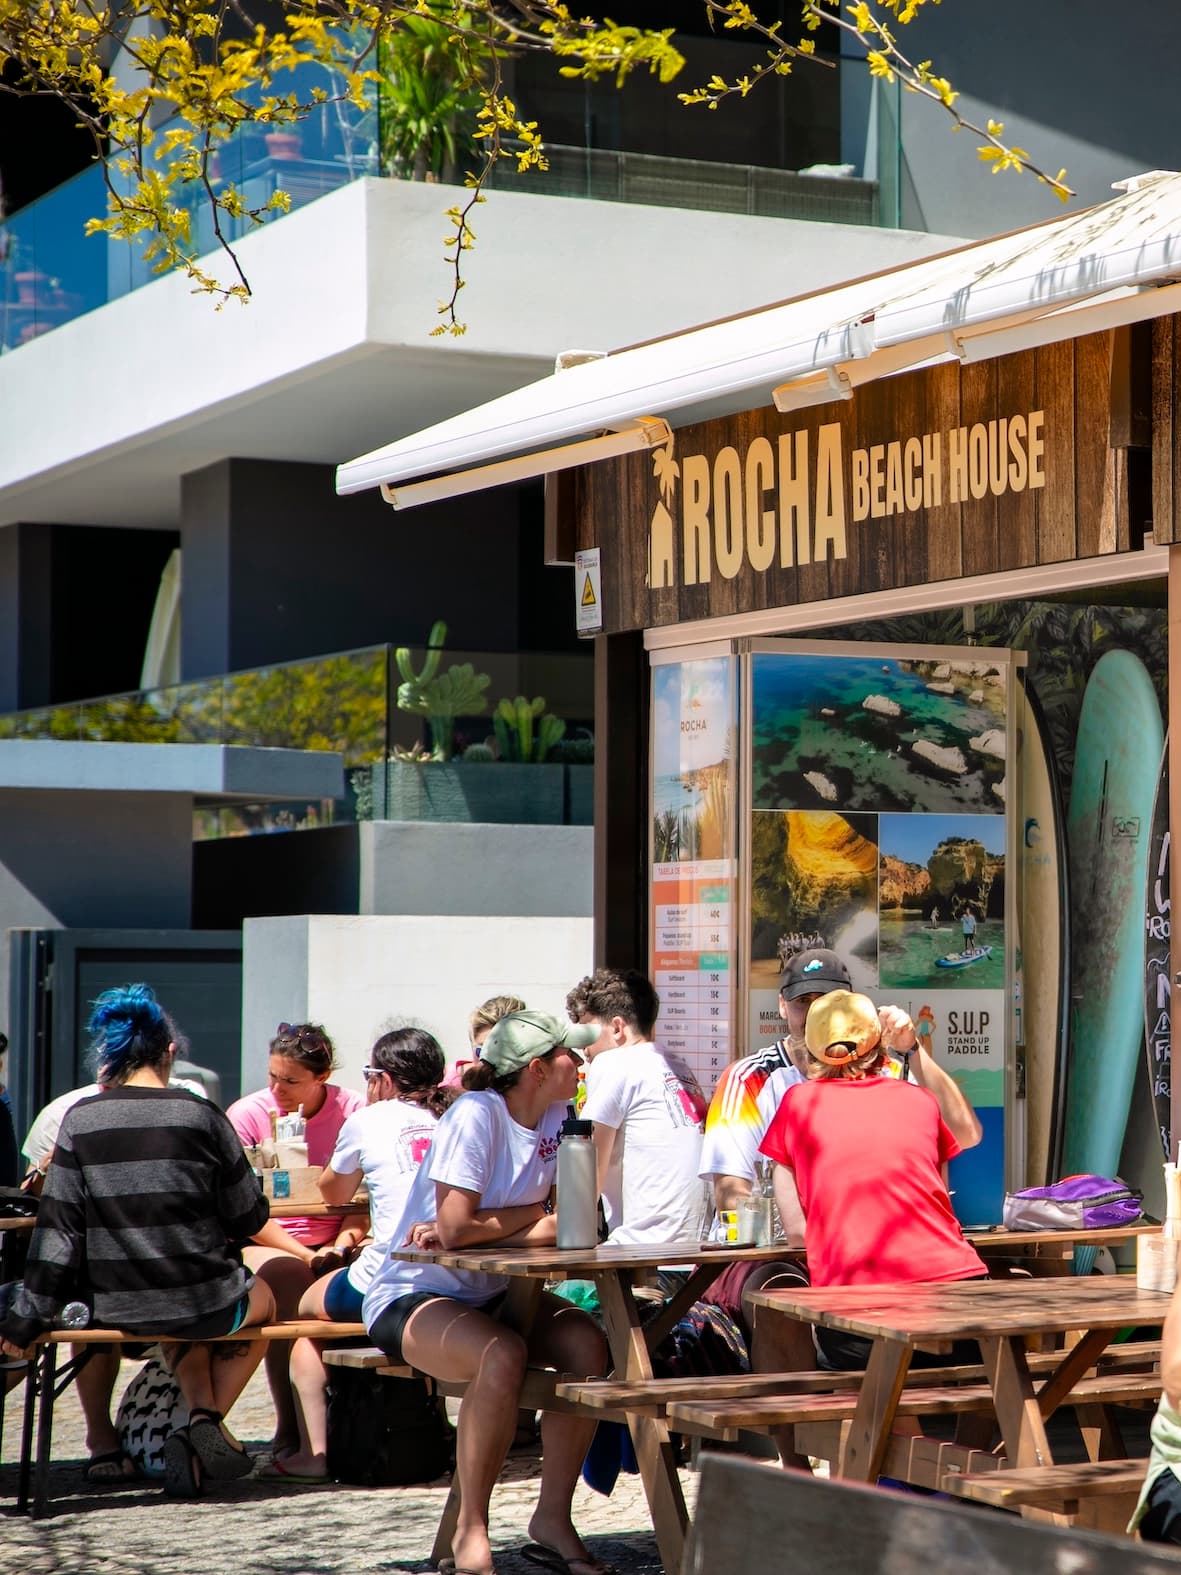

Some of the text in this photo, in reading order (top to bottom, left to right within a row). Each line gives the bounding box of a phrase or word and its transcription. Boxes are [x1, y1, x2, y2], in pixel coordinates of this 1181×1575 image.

[682, 410, 1046, 586] ROCHA BEACH HOUSE
[680, 719, 707, 732] ROCHA
[948, 1011, 990, 1035] S.U.P
[759, 1024, 776, 1034] BOOK
[948, 1037, 990, 1045] STAND UP
[947, 1045, 990, 1055] PADDLE
